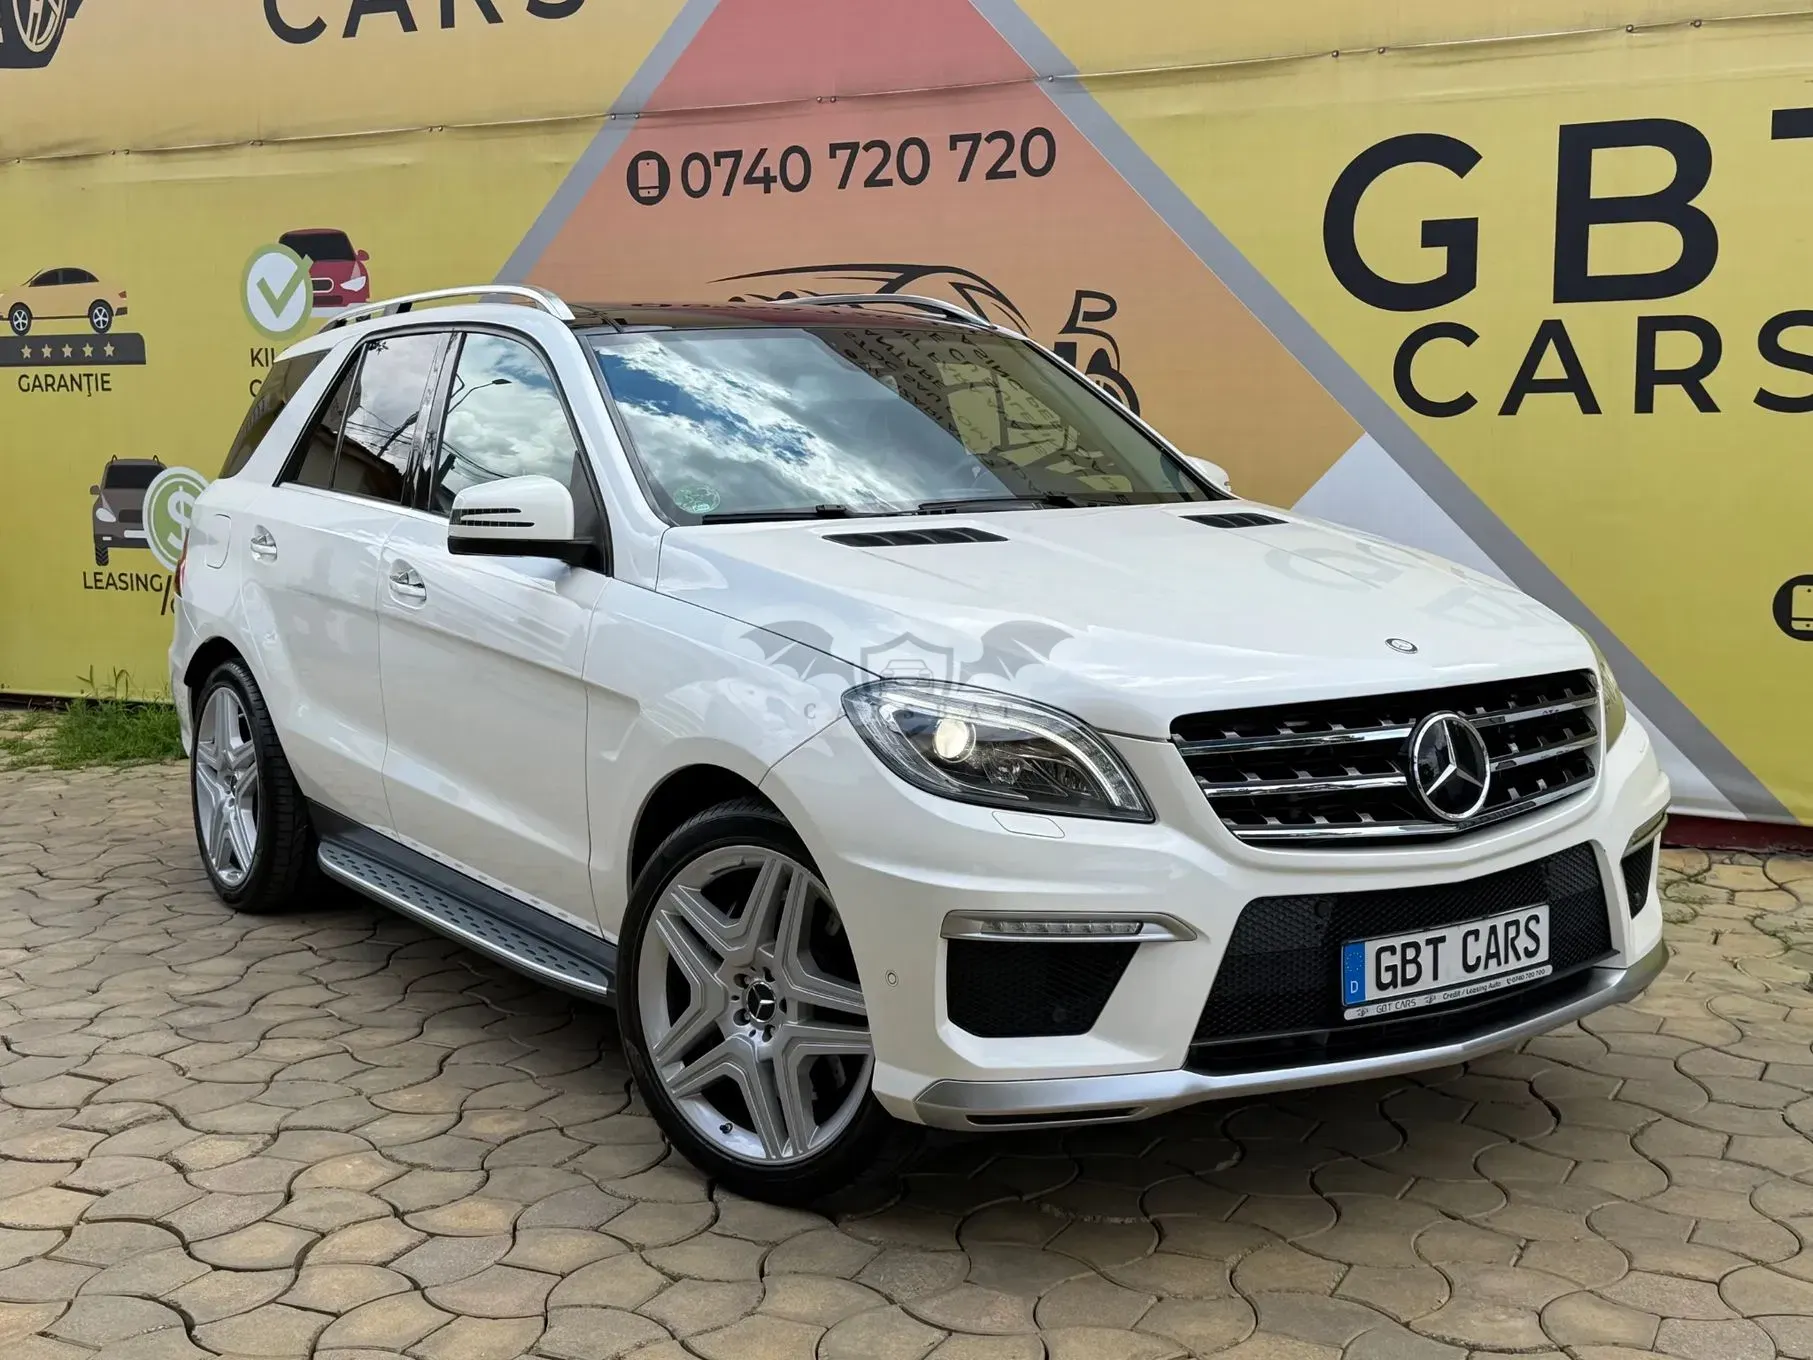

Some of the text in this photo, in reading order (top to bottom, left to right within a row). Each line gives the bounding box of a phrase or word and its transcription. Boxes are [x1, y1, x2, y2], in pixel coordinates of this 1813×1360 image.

[681, 126, 1057, 199] 0740 720 720
[1375, 914, 1541, 991] GBT CARS
[1350, 980, 1359, 994] D
[1376, 1001, 1392, 1014] GBT
[1394, 998, 1417, 1010] CARS
[1442, 989, 1461, 1000] Credit
[1466, 984, 1488, 995] Leasing
[1488, 981, 1502, 990] Auto
